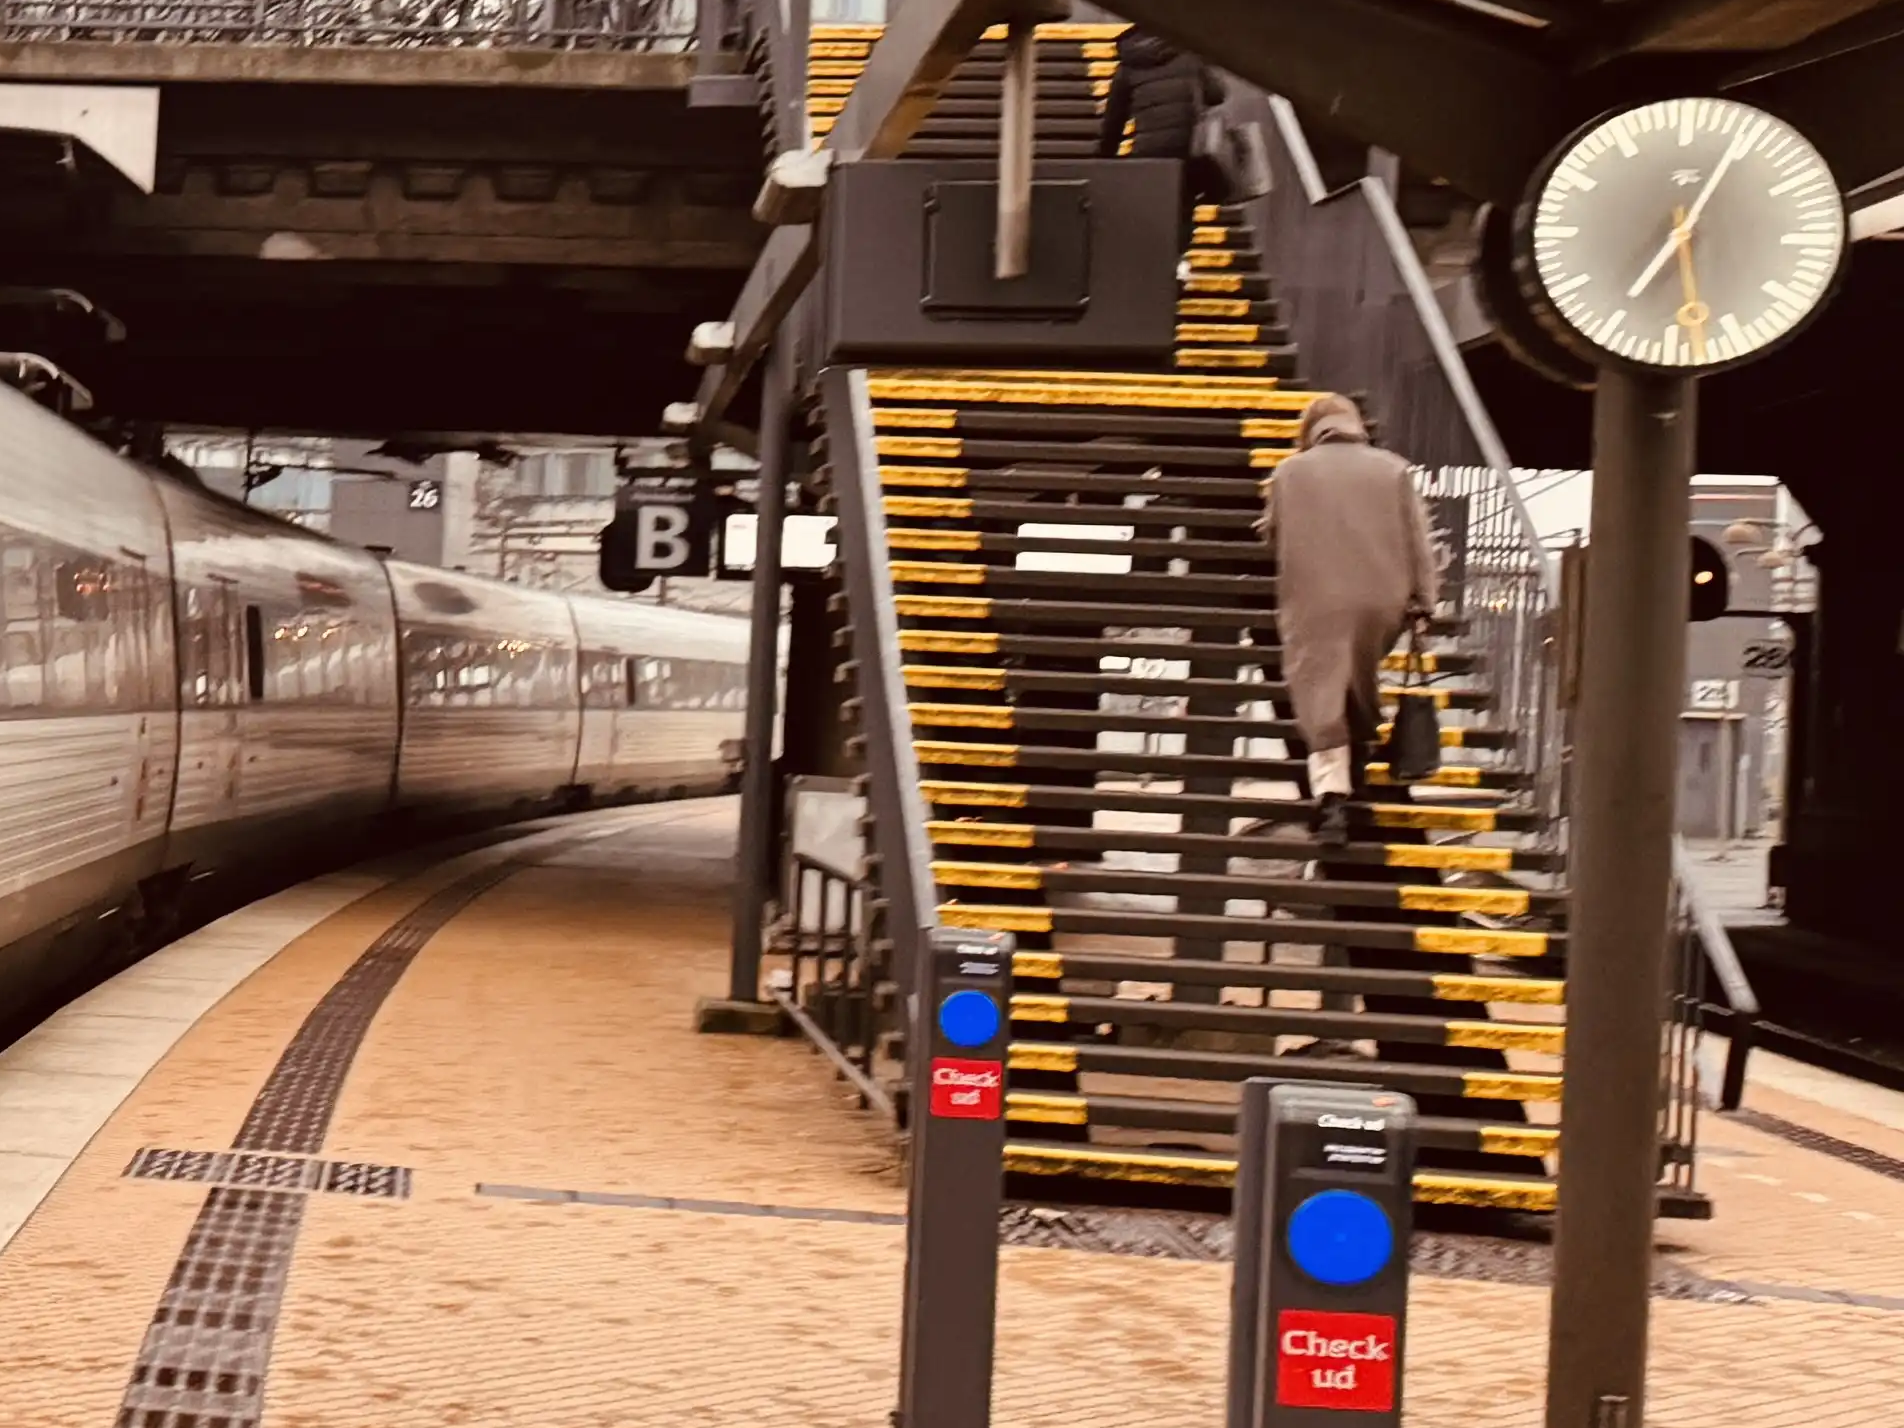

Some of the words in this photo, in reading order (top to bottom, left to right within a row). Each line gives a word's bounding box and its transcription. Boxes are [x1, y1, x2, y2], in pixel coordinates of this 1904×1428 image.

[410, 488, 439, 509] 26
[635, 505, 690, 569] B
[1280, 1329, 1392, 1361] Check
[1311, 1364, 1358, 1390] ud
